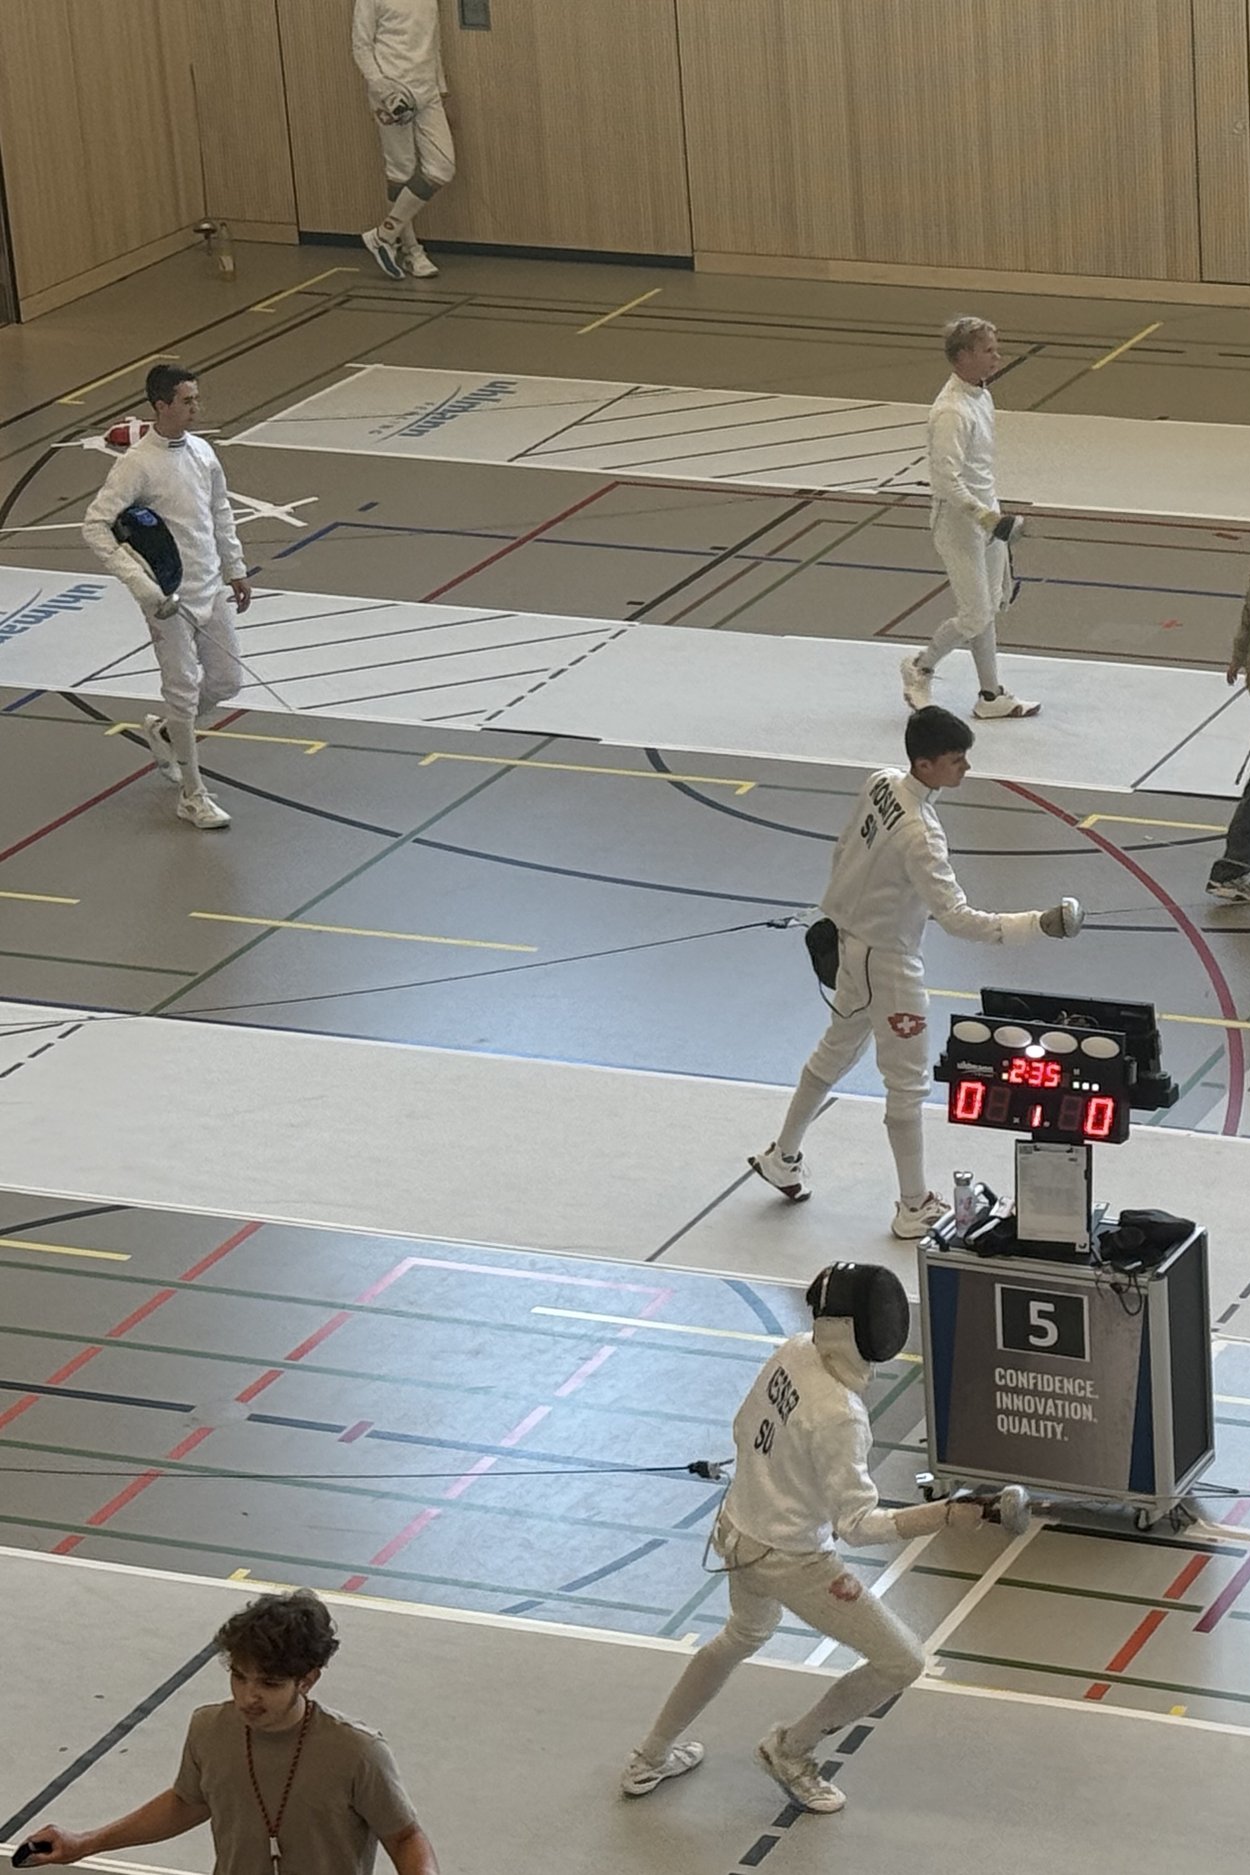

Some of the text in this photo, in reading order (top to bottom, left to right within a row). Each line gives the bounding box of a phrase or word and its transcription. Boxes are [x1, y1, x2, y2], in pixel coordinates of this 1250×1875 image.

[399, 381, 518, 437] uhlmann
[0, 584, 107, 644] uhlma
[956, 1081, 986, 1120] 0
[1084, 1096, 1115, 1136] 0
[1029, 1300, 1059, 1347] 5
[995, 1367, 1099, 1400] CONFIDENCE.
[996, 1391, 1098, 1423] INNOVATION.
[997, 1414, 1069, 1442] QUALITY.
